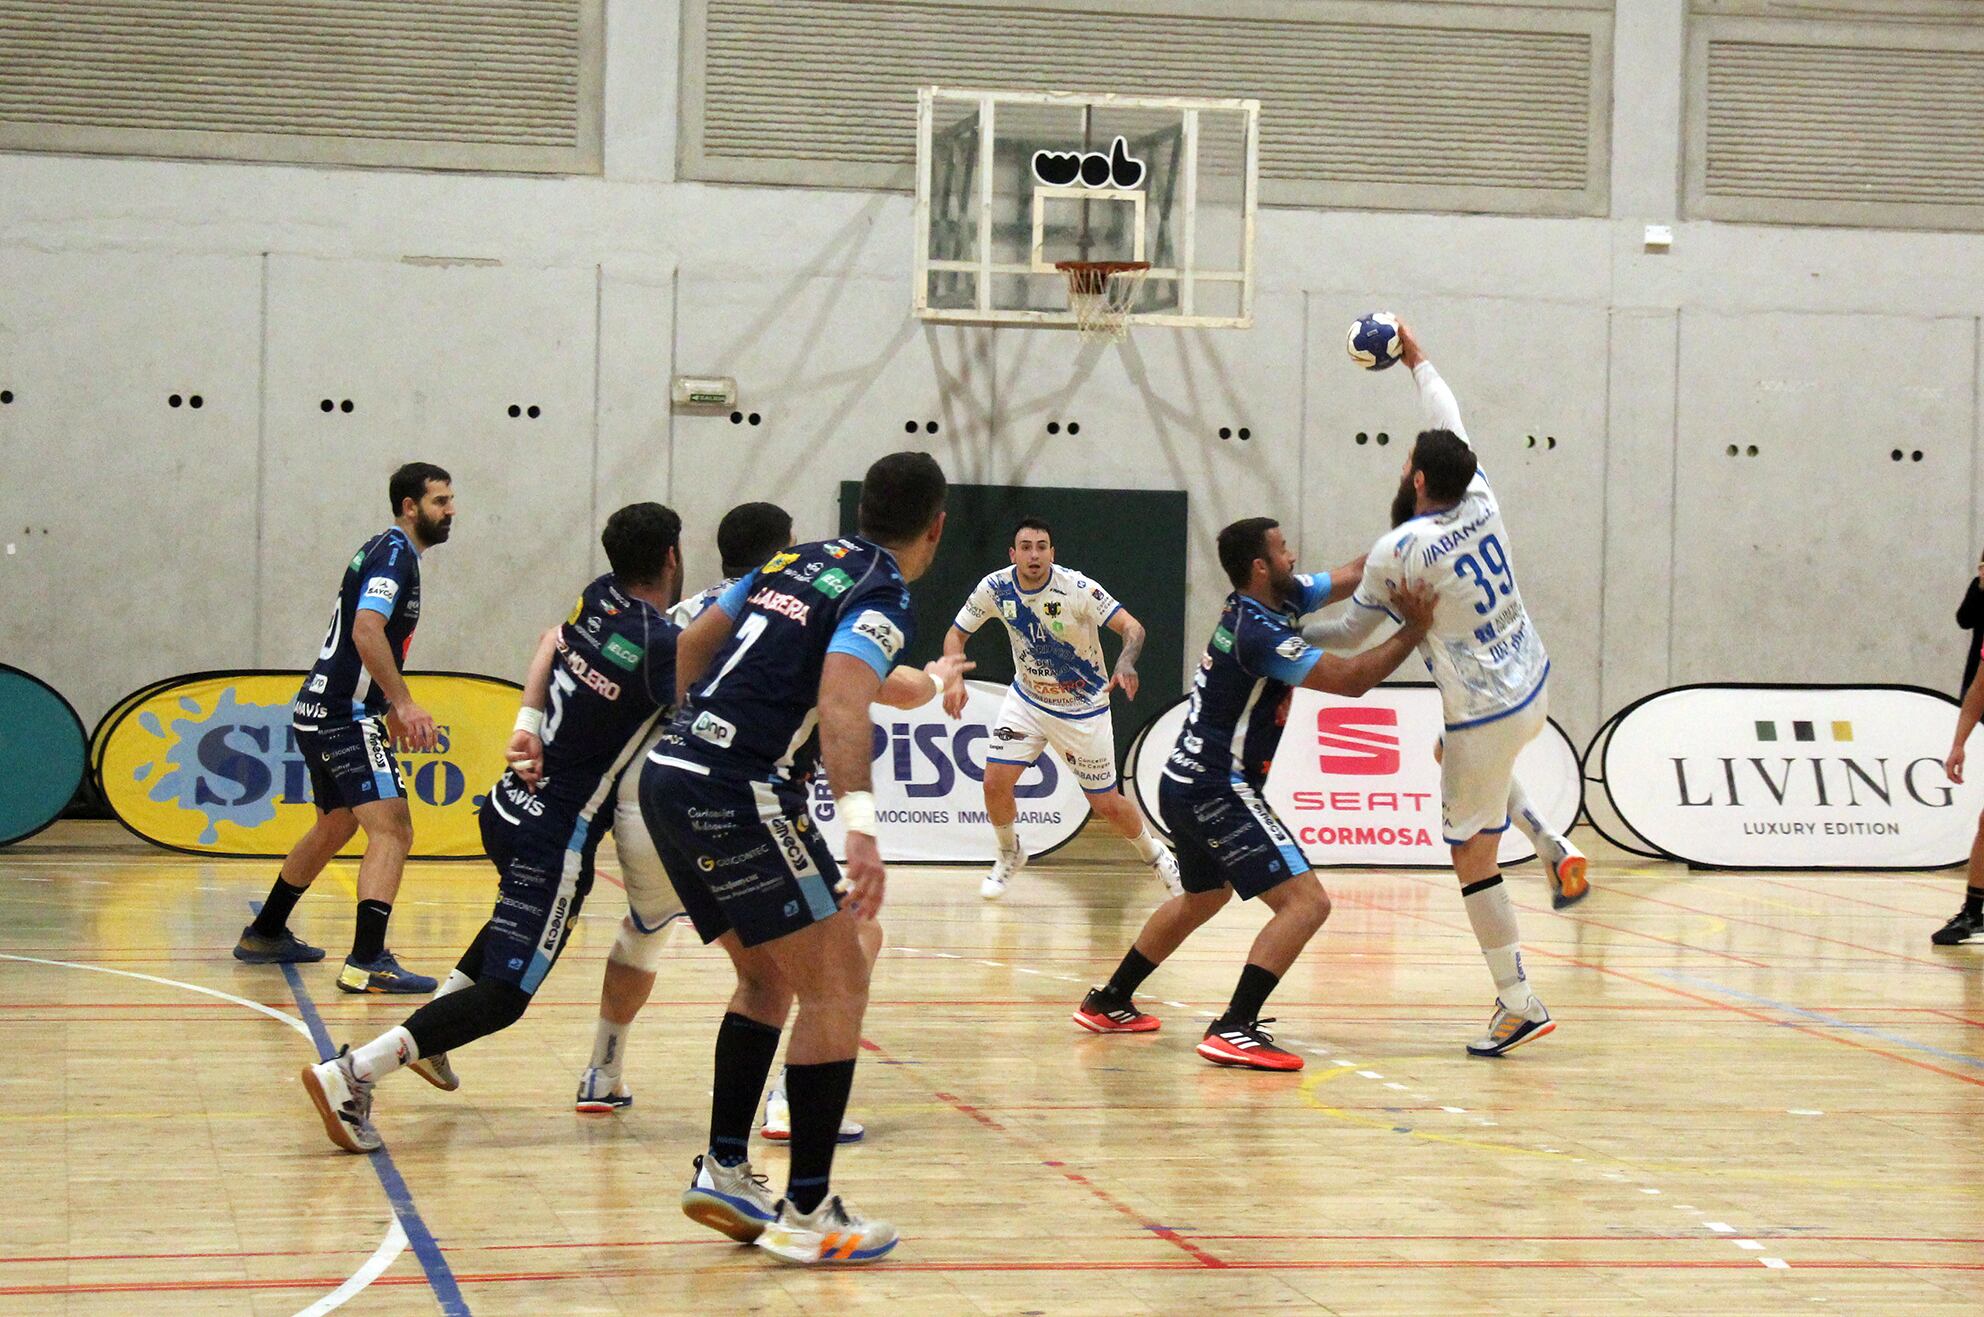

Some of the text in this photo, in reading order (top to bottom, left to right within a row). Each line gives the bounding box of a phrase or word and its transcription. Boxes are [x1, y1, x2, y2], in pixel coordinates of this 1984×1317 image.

[1454, 533, 1514, 616] 39
[1028, 622, 1046, 643] 14
[700, 612, 769, 697] 7
[1669, 757, 1955, 808] LIVING
[1293, 791, 1432, 812] SEAT
[1300, 827, 1433, 846] CORMOSA
[1744, 822, 1900, 835] LUXURY EDITION
